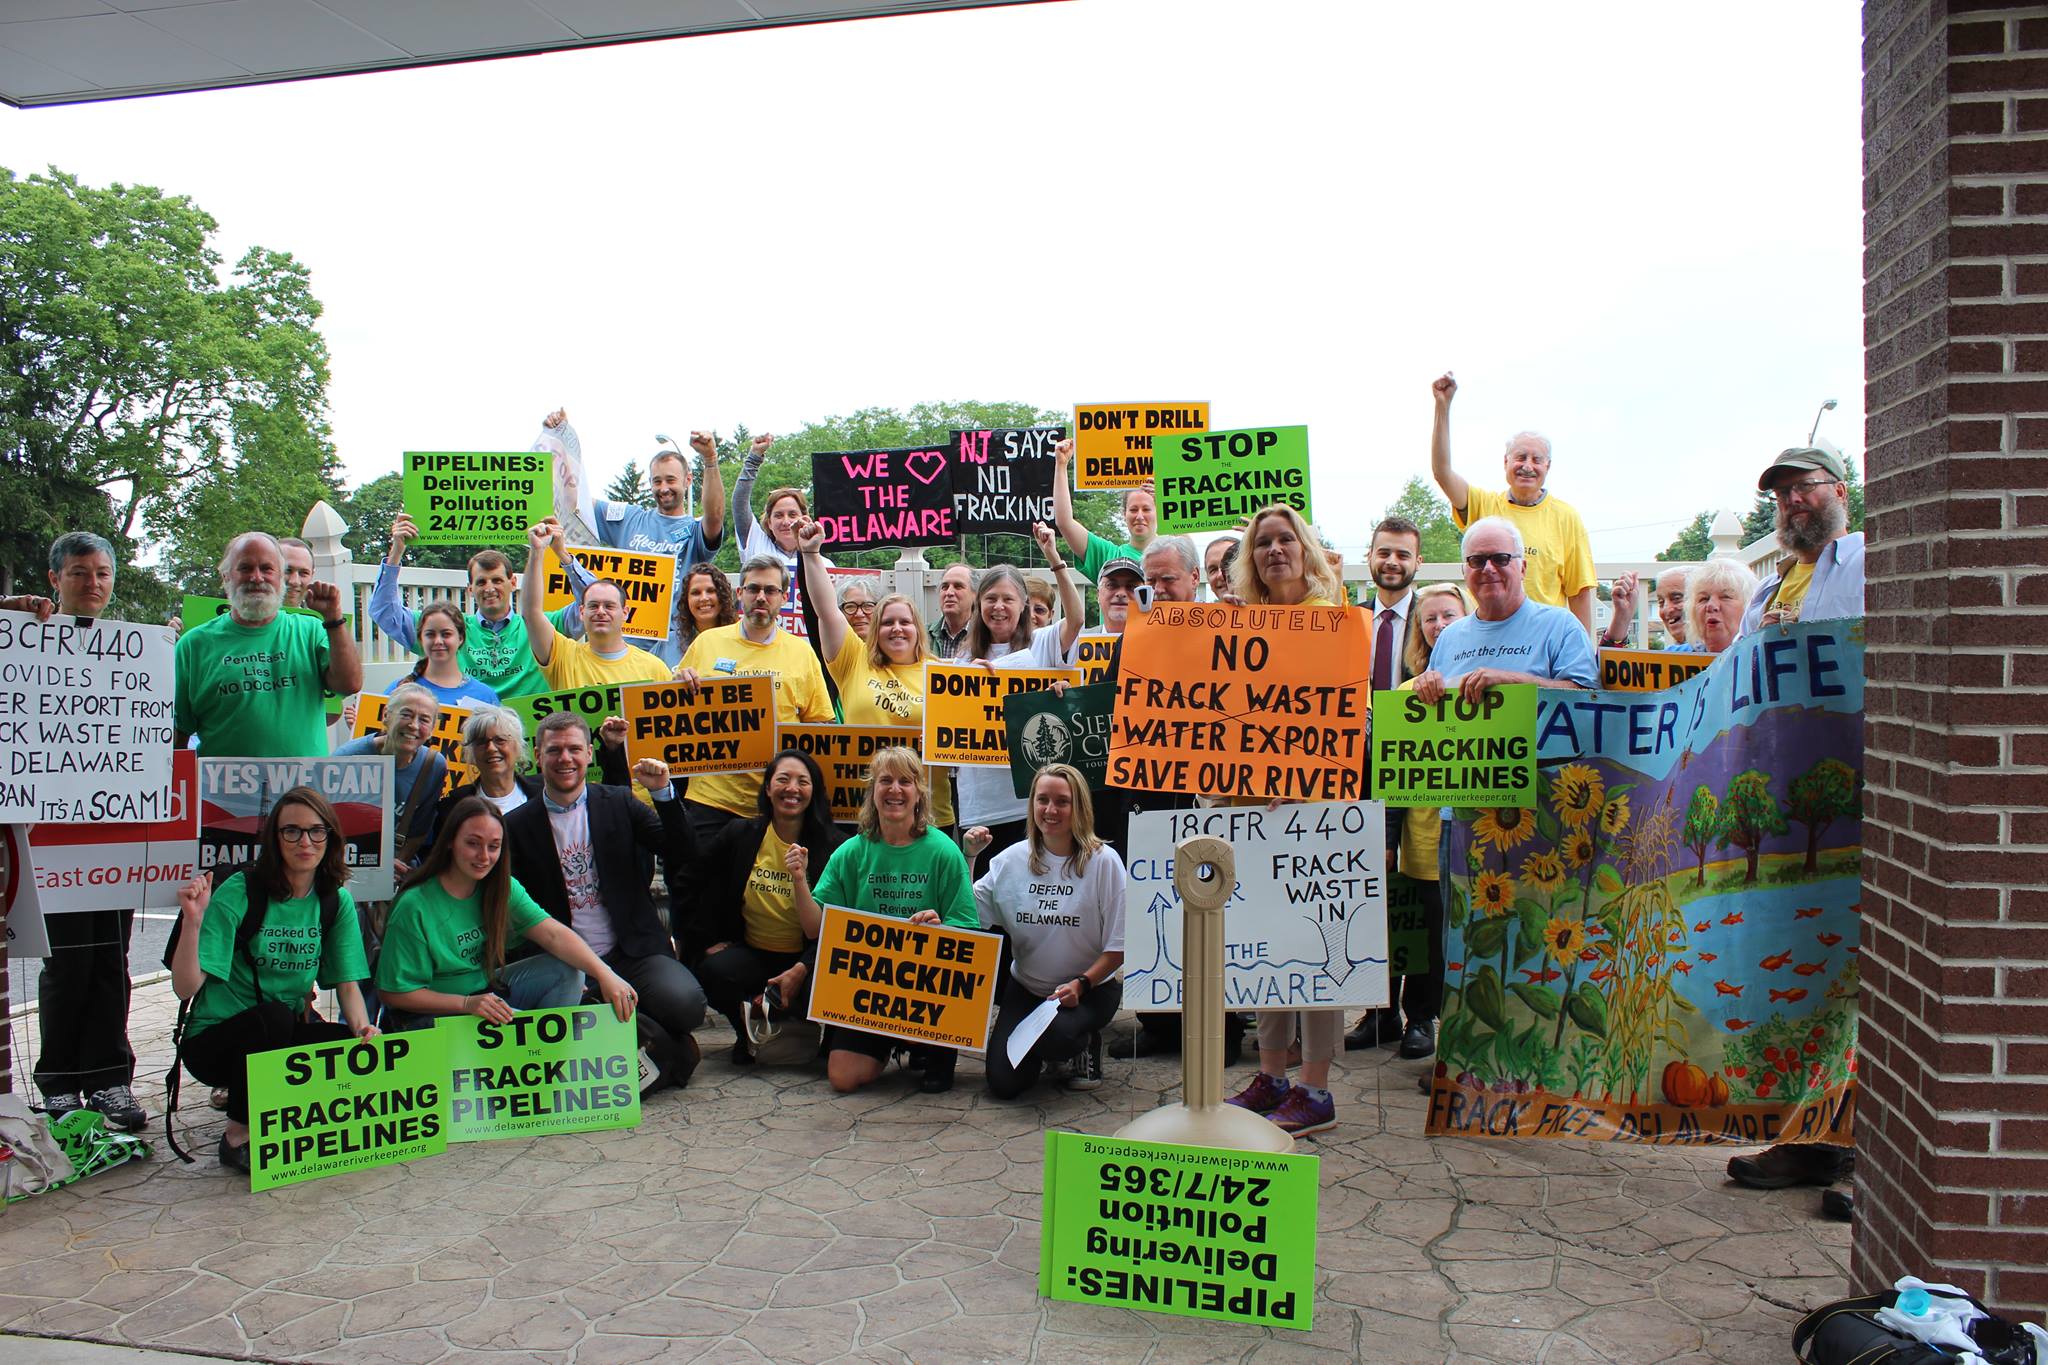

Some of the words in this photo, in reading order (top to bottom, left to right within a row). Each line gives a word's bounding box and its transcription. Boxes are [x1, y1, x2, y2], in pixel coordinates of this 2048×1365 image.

[1079, 410, 1138, 430] DON'T
[1145, 409, 1204, 429] DRILL
[960, 431, 992, 464] NJ
[1003, 430, 1059, 460] SAYS
[1124, 435, 1153, 450] THE
[1181, 431, 1278, 462] STOP
[412, 455, 545, 472] PIPELINES:
[841, 453, 889, 479] WE
[1086, 456, 1153, 477] DELAW
[423, 475, 534, 495] Delivering
[978, 465, 1011, 493] NO
[1085, 478, 1148, 487] www.delawareriv
[1162, 468, 1303, 497] FRACKING
[430, 496, 528, 511] Pollution
[858, 485, 909, 509] THE
[953, 493, 1055, 522] FRACKING
[430, 515, 528, 531] 24/7/365
[819, 508, 953, 545] DELAWARE
[420, 533, 529, 541] www.delawareriverkeeper.
[629, 534, 684, 553] Keeping
[628, 558, 657, 577] BE
[548, 574, 666, 604] FKIN'
[1147, 606, 1345, 633] ABSOLUTELY
[86, 628, 143, 662] 440
[1211, 635, 1269, 672] NO
[1478, 646, 1495, 657] the
[1496, 644, 1532, 658] frack!
[223, 651, 286, 666] PennEast
[3, 664, 92, 688] OVIDES
[111, 671, 152, 692] FOR
[244, 666, 270, 678] Lies
[1605, 660, 1662, 689] DON'T
[219, 681, 239, 697] NO
[243, 676, 297, 692] DOCKET
[643, 686, 714, 711] DON'T
[721, 684, 753, 704] BE
[931, 673, 1000, 698] DON'T
[1123, 677, 1231, 712] FRACK
[1246, 683, 1357, 718] WASTE
[1538, 701, 1679, 756] ATER
[1731, 635, 1847, 714] LIFE
[0, 692, 28, 715] ER
[40, 694, 127, 717] EXPORT
[131, 700, 174, 719] FROM
[983, 705, 1005, 721] TH
[1404, 691, 1505, 724] STOP
[0, 721, 28, 744] CK
[39, 721, 121, 744] WASTE
[132, 726, 173, 744] INTO
[635, 708, 766, 740] FRACKIN'
[1122, 716, 1226, 751] WATER
[1240, 723, 1360, 758] EXPORT
[1445, 725, 1457, 733] THE
[781, 734, 850, 757] DON'T
[937, 726, 1008, 751] DELA
[1380, 736, 1529, 762] FRACKING
[11, 750, 144, 776] DELAWARE
[663, 740, 740, 764] CRAZY
[934, 751, 1010, 763] www.delawareriv
[205, 763, 260, 795] YES
[266, 763, 315, 795] WE
[322, 764, 382, 795] CAN
[668, 759, 769, 774] elawareriverkeeper.org
[1113, 756, 1190, 790] SAVE
[1199, 762, 1254, 796] OUR
[1264, 766, 1359, 800] RIVER
[1379, 765, 1529, 790] PIPELINES
[72, 799, 85, 821] A
[89, 784, 169, 821] SCAM!
[1388, 793, 1517, 803] www.delawareriverkeeper.org
[201, 844, 248, 868] BAN
[1272, 849, 1370, 880] FRACK
[34, 866, 84, 888] East
[87, 866, 121, 885] GO
[127, 863, 193, 884] HOME
[756, 868, 794, 882] COMPL
[868, 872, 897, 885] Entire
[900, 873, 929, 885] ROW
[750, 880, 791, 897] Fracking
[873, 888, 922, 901] Requires
[1029, 883, 1073, 896] DEFEND
[1286, 877, 1380, 905] WASTE
[1037, 900, 1058, 911] THE
[1318, 900, 1345, 923] IN
[1016, 912, 1080, 928] DELAWARE
[268, 941, 316, 954] STINKS
[845, 920, 929, 956] DON'T
[935, 936, 975, 964] BE
[1225, 942, 1268, 960] THE
[829, 947, 986, 1000] FRACKIN'
[1151, 973, 1334, 1005] DWARE
[853, 989, 945, 1027] CRAZY
[476, 1010, 597, 1050] STOP
[822, 1009, 973, 1047] www.delawareriverkeeper.org
[285, 1038, 410, 1086] STOP
[528, 1048, 542, 1057] THE
[337, 1081, 352, 1092] THE
[452, 1055, 628, 1093] FRACKING
[260, 1084, 439, 1137] FRACKING
[452, 1083, 632, 1124] PIPELINES
[1430, 1088, 1530, 1137] FRACK
[1533, 1101, 1605, 1137] FREE
[464, 1111, 620, 1135] www.delawareriverkeeper.org
[259, 1113, 440, 1170] PIPELINES
[271, 1143, 428, 1183] www.delawareriverkeeper.org
[1084, 1141, 1289, 1173] www.delawareriverkeeper.org
[1100, 1163, 1271, 1207] 24/7/365
[1100, 1199, 1267, 1244] Pollution
[1086, 1226, 1277, 1282] Delivering
[1067, 1265, 1295, 1321] PIPELINES:
